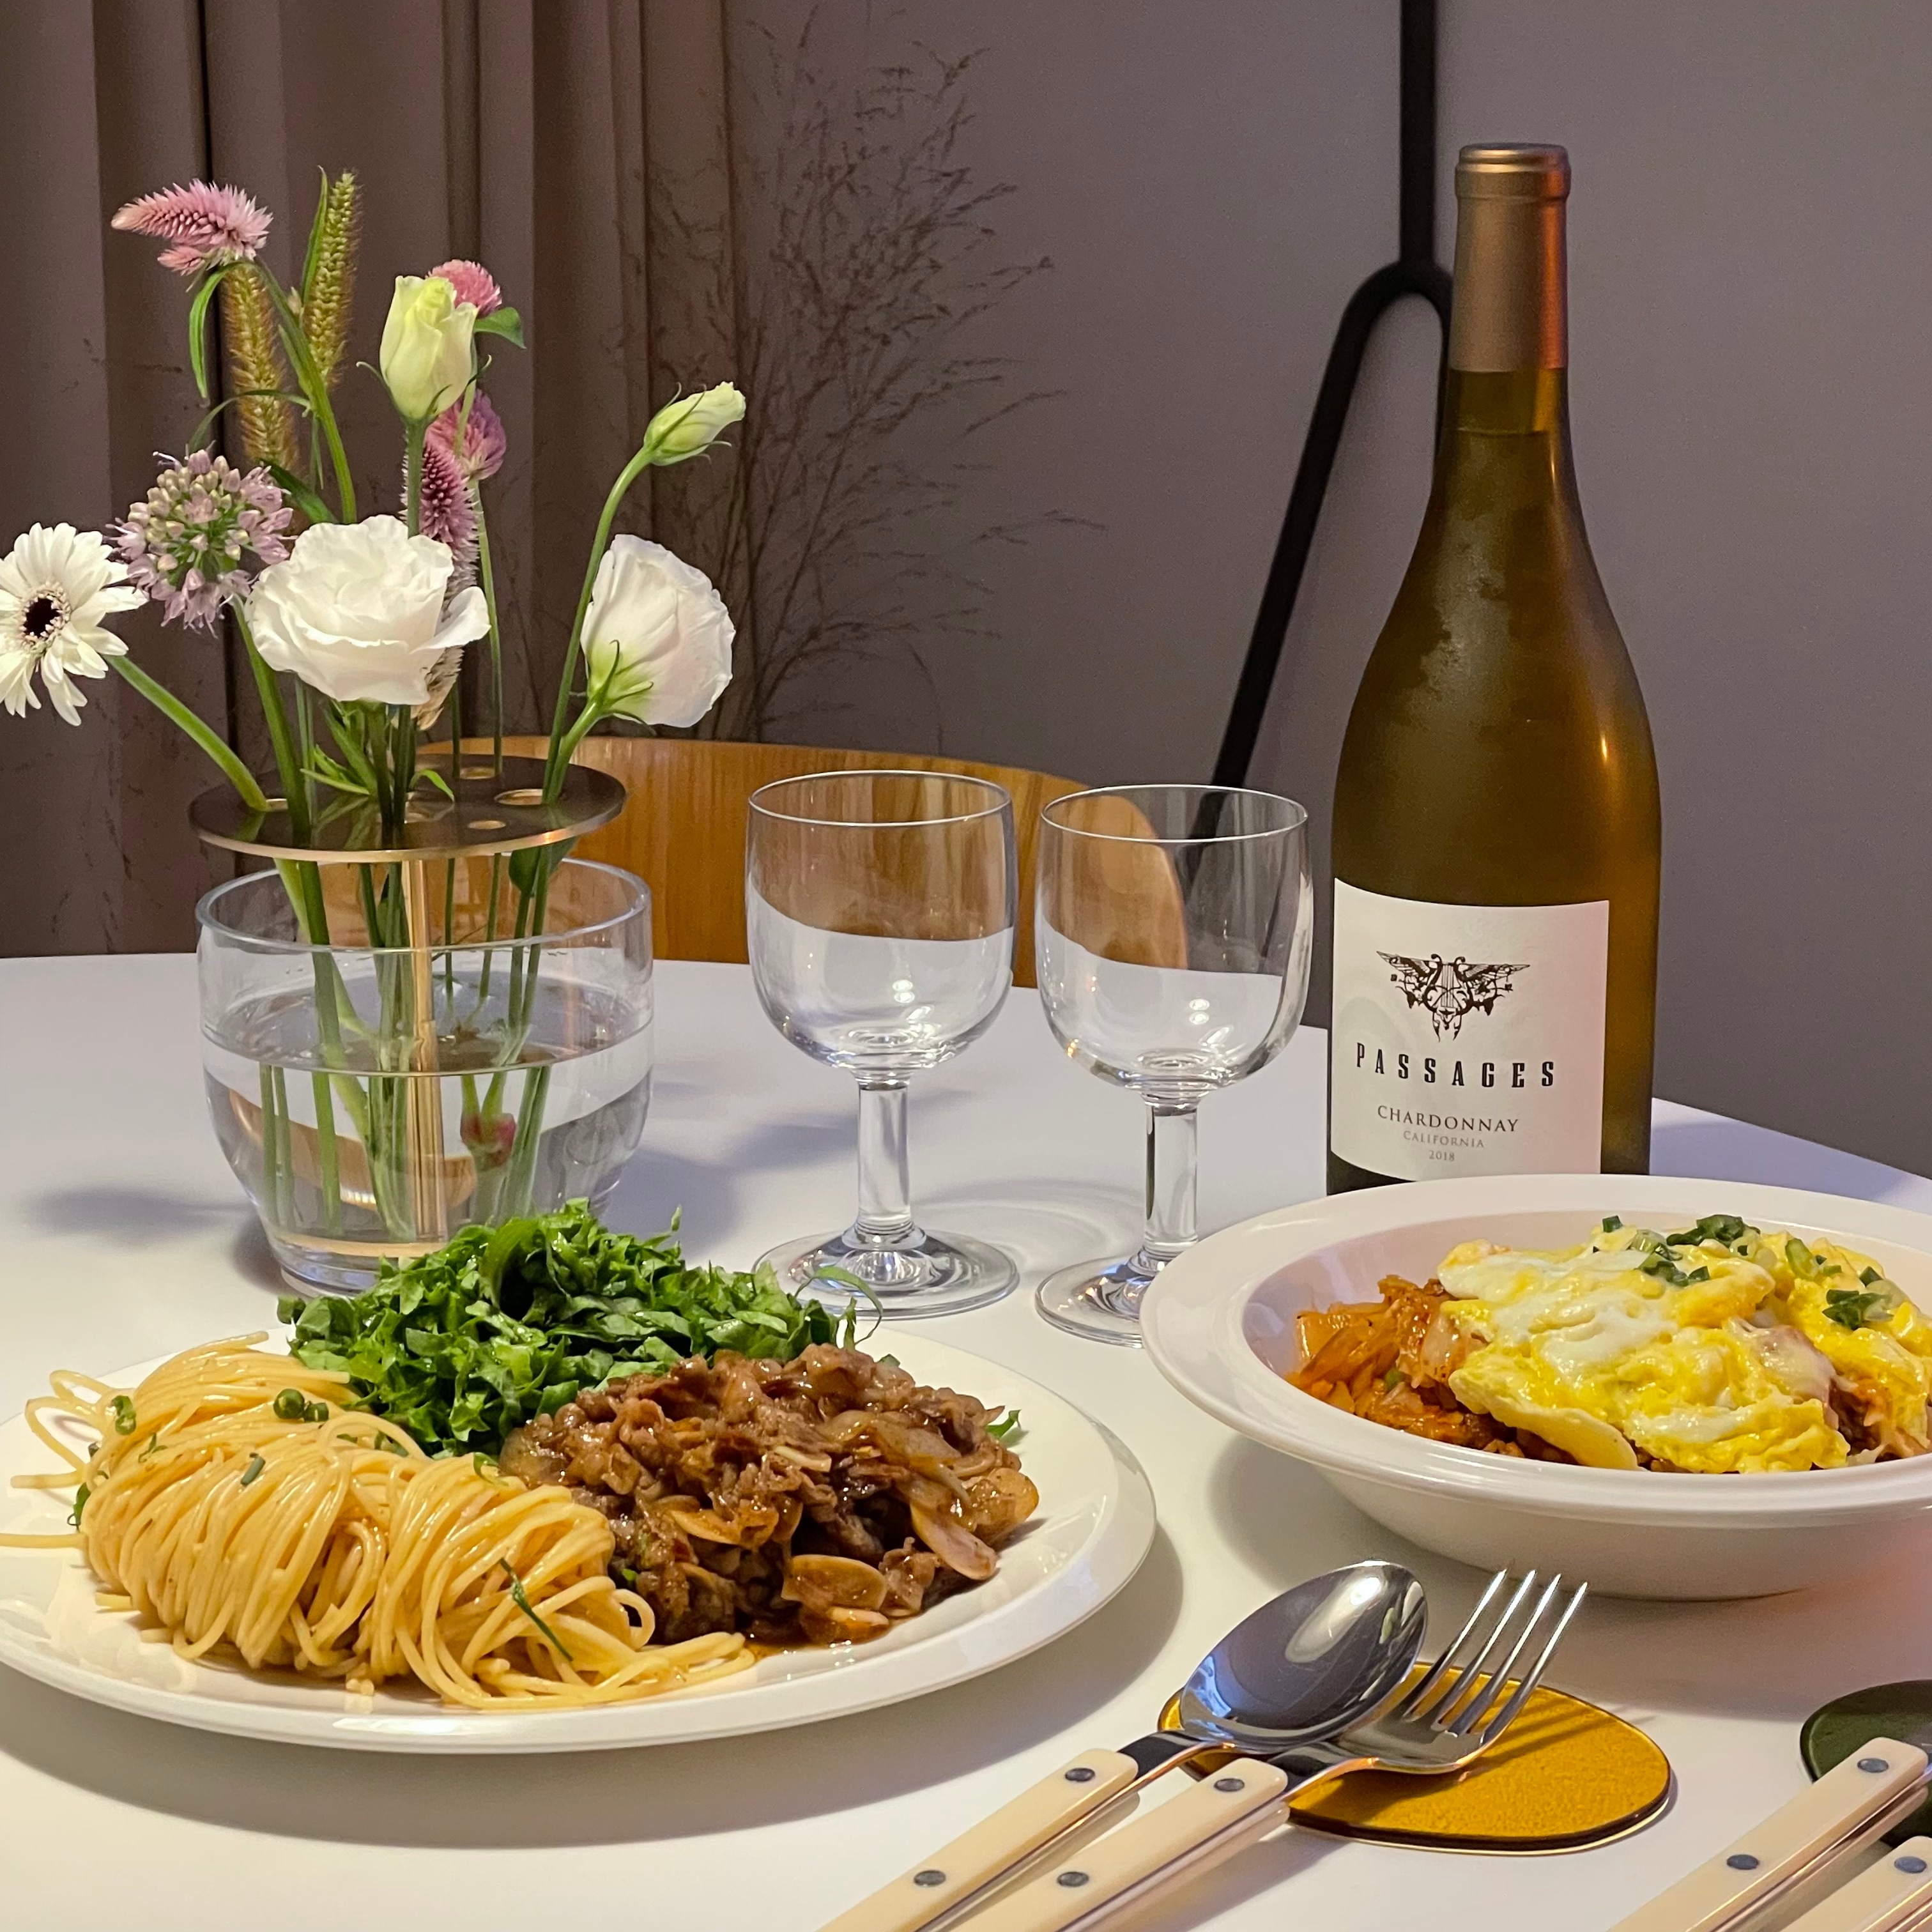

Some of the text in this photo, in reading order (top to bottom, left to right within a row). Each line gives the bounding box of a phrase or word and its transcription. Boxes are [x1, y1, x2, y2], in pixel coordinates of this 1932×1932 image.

[1356, 1042, 1554, 1088] PASSAGES
[1377, 1105, 1519, 1132] CHARDONNAY
[1403, 1130, 1484, 1148] CALIFORNIA
[1429, 1150, 1455, 1162] 2018
